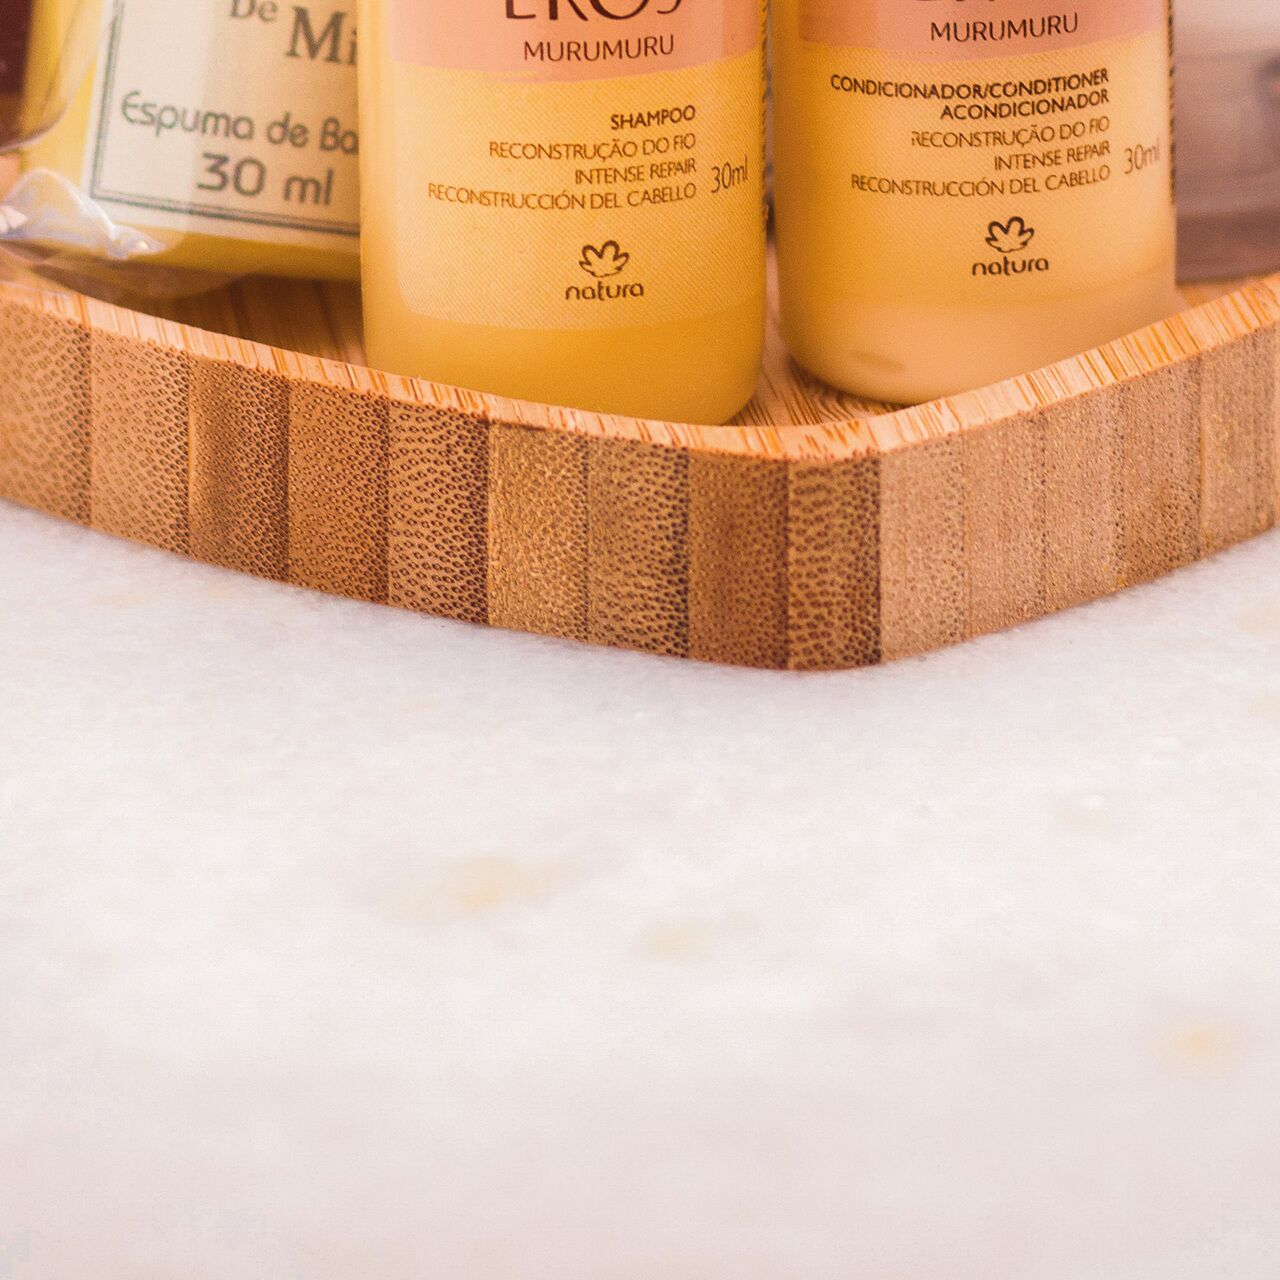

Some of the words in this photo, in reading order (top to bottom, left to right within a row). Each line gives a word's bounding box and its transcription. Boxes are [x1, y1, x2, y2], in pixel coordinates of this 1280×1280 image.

[929, 12, 1079, 43] MURUMURU
[523, 34, 675, 63] MURUMURU
[830, 67, 1110, 101] CONDICIONADOR/CONDITIONER
[120, 89, 254, 139] Espuma
[266, 112, 309, 150] de
[609, 104, 697, 132] SHAMPOO
[939, 89, 1110, 121] ACONDICIONADOR
[488, 137, 638, 162] RECONSTRUÇÃO
[641, 136, 670, 157] DO
[910, 124, 1056, 150] RECONSTRUÇÃO
[1058, 121, 1086, 142] DO
[574, 166, 646, 186] INTENSE
[649, 157, 698, 181] REPAIR
[993, 150, 1064, 173] INTENSE
[1065, 140, 1111, 164] REPAIR
[196, 151, 267, 198] 30
[283, 168, 335, 207] ml
[709, 155, 750, 195] 30ml
[850, 173, 1006, 198] RECONSTRUCCIÓN
[1009, 175, 1041, 196] DEL
[1044, 164, 1111, 192] CABELLO
[427, 181, 586, 211] RECONSTRUCCIÓN
[589, 190, 623, 211] DEL
[626, 182, 698, 208] CABELLO
[971, 254, 1051, 278] natura
[564, 279, 645, 302] natura
